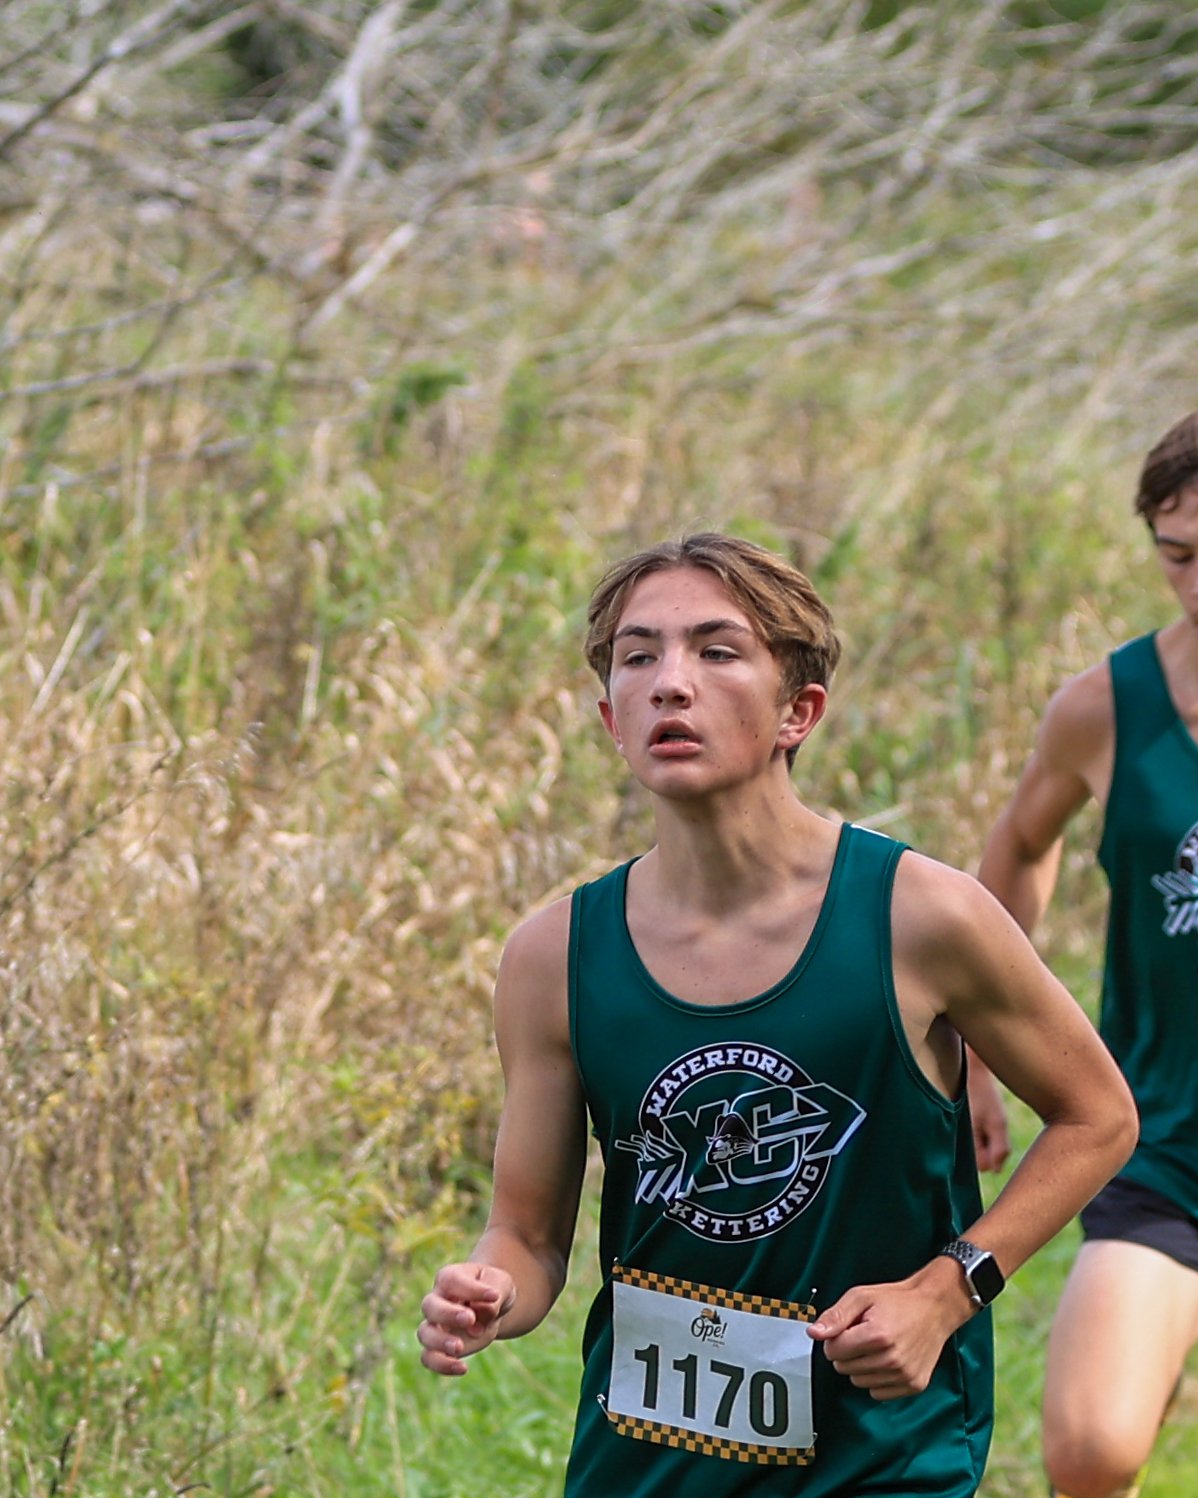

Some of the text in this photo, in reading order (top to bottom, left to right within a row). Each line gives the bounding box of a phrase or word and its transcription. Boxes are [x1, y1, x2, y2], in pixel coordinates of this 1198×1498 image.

[645, 1047, 795, 1118] WATERFORD
[668, 1163, 820, 1237] KETTERING
[690, 1316, 728, 1342] Ope!
[633, 1343, 790, 1438] 1170
